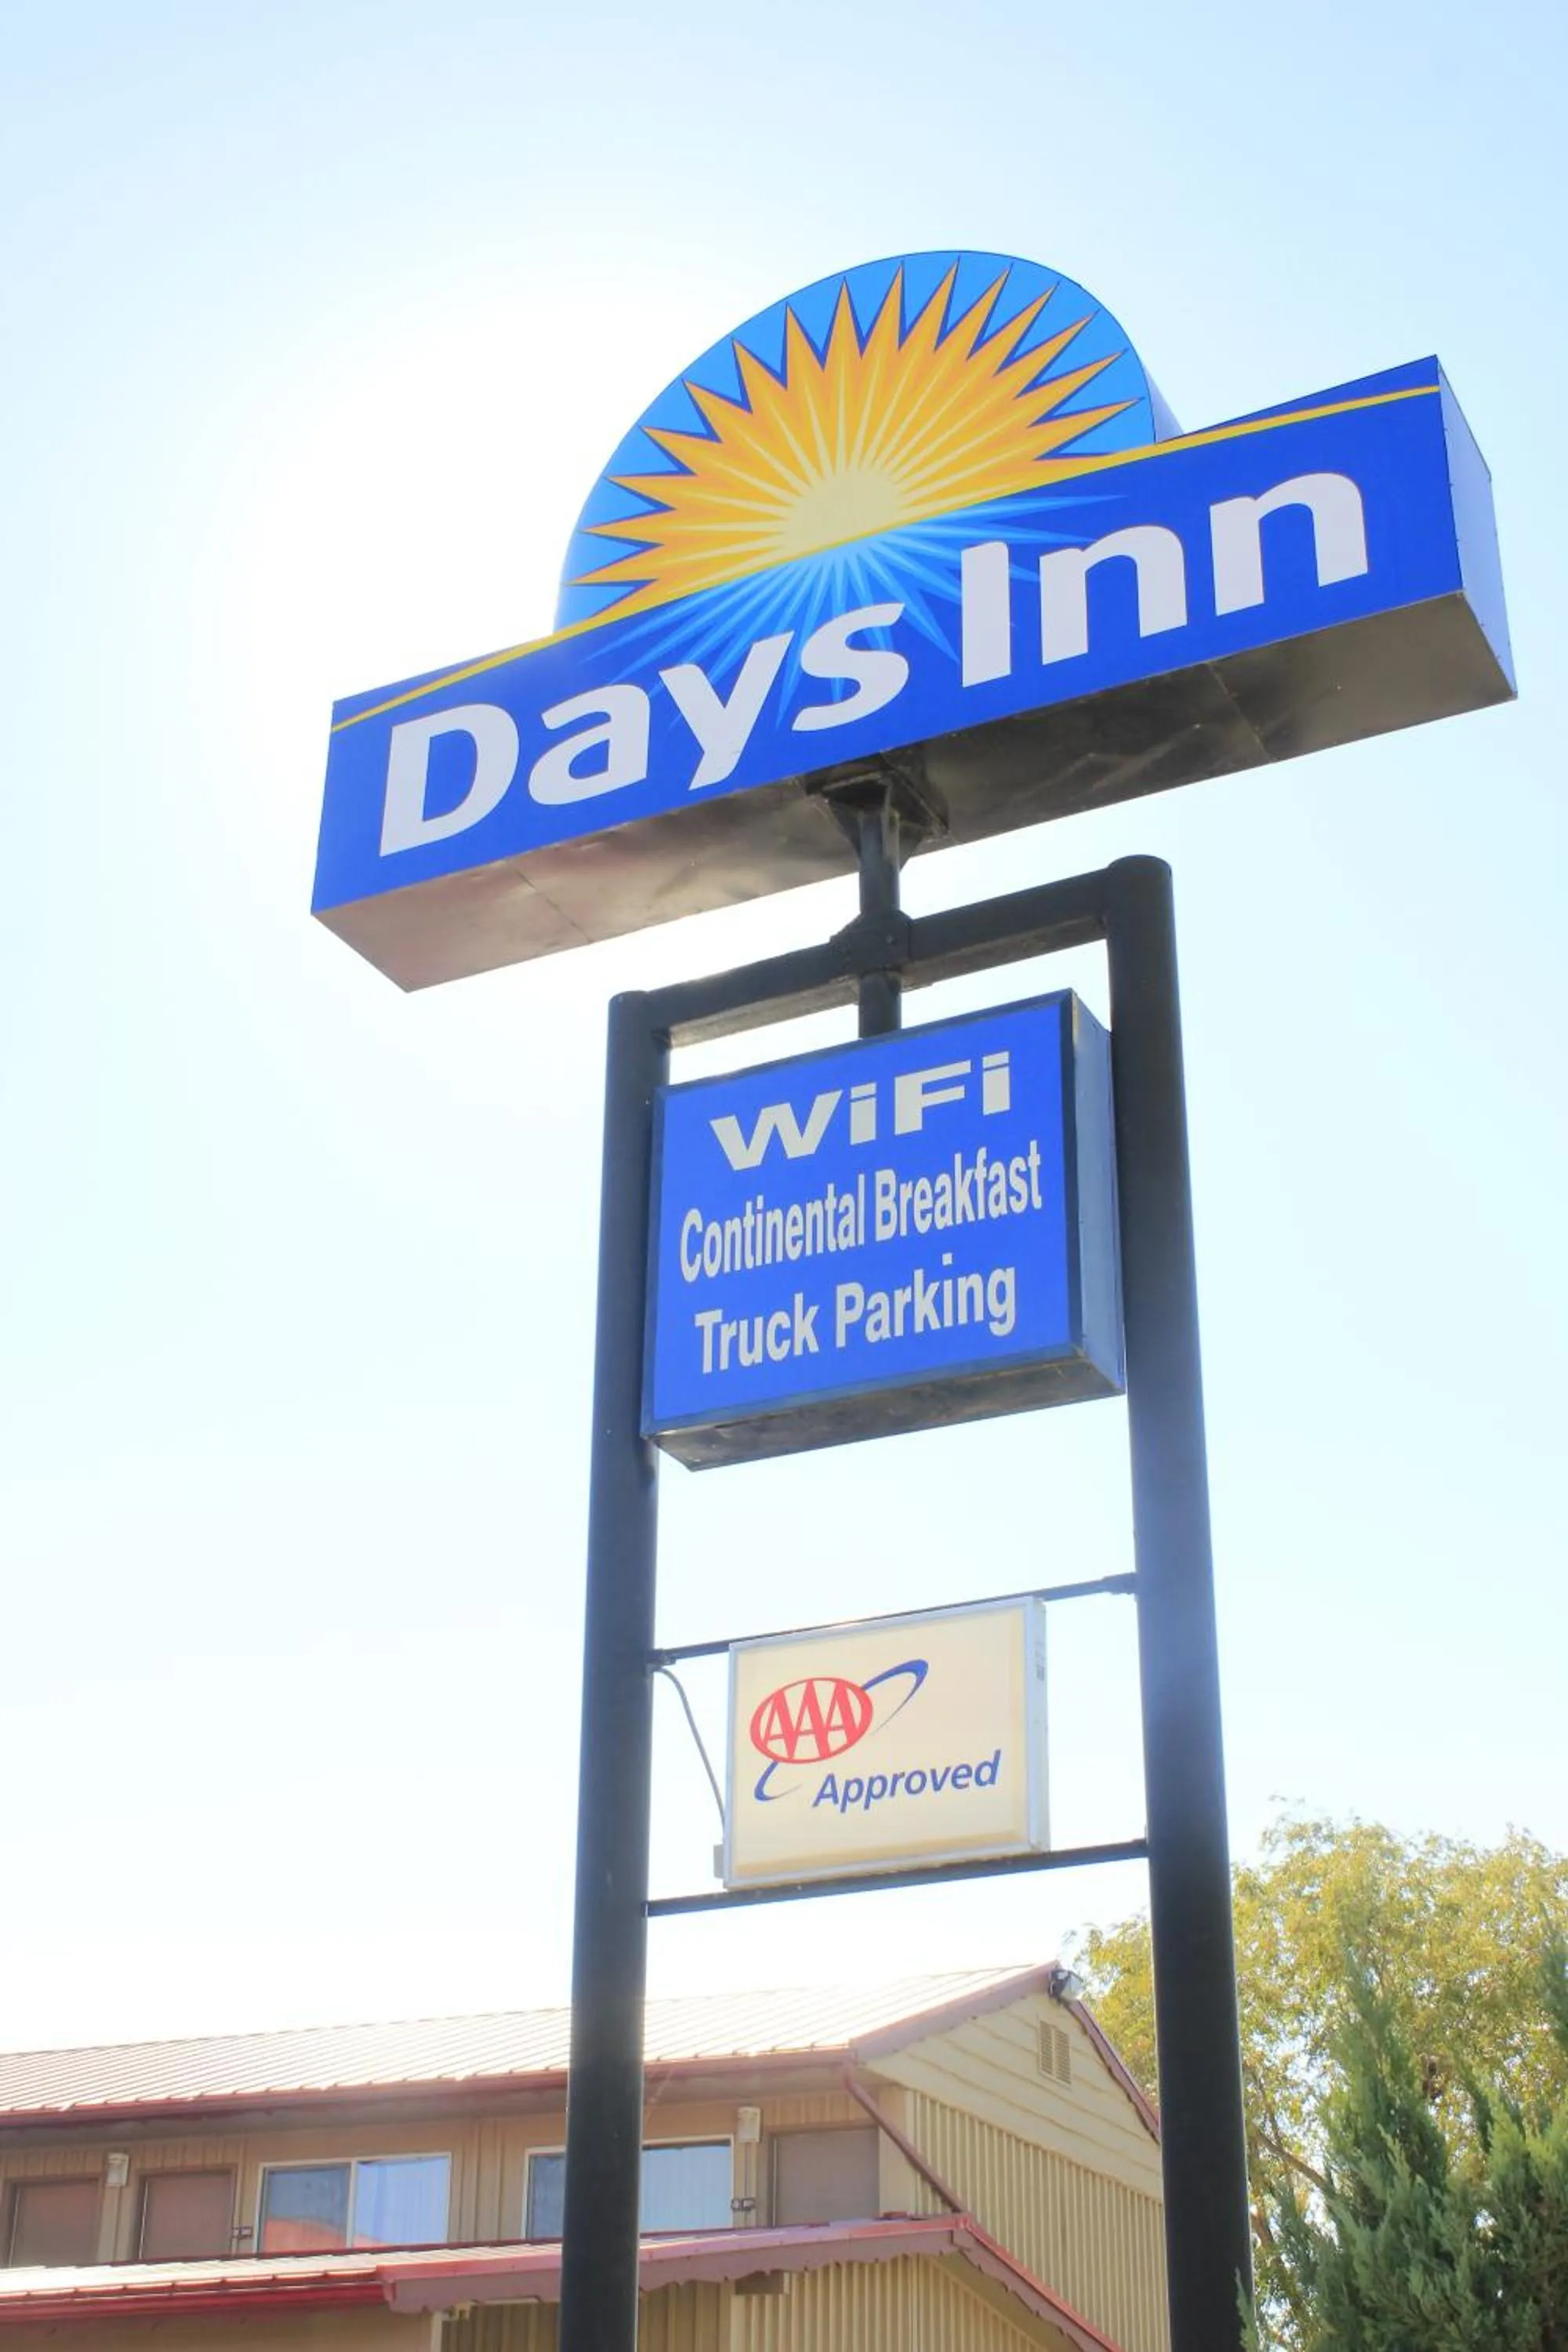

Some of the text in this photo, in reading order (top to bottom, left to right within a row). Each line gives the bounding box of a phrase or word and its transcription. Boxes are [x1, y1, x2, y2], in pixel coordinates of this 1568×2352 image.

[378, 472, 1368, 858] Days Inn
[709, 1051, 1011, 1171] WiFi
[680, 1140, 1043, 1283] Continental Breakfast
[695, 1252, 1017, 1374] Truck Parking
[763, 1679, 858, 1760] AAA
[811, 1749, 1001, 1813] Approved
